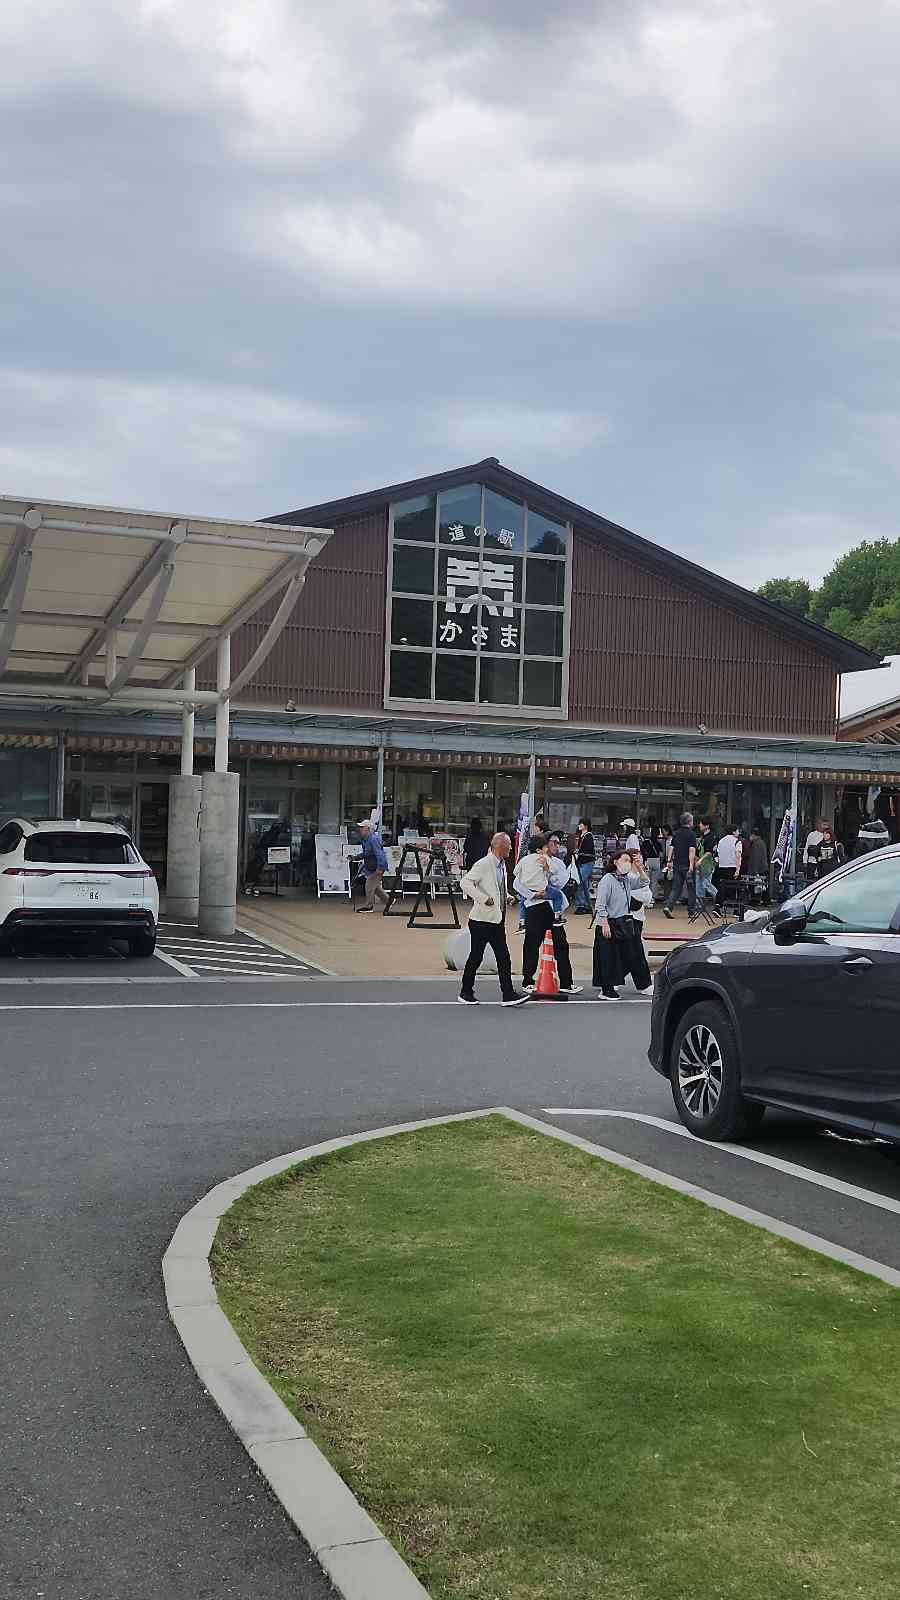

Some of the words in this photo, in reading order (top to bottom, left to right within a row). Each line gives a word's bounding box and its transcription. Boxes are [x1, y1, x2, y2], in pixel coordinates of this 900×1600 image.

[448, 523, 515, 547] 道の駅
[440, 619, 518, 647] かさま
